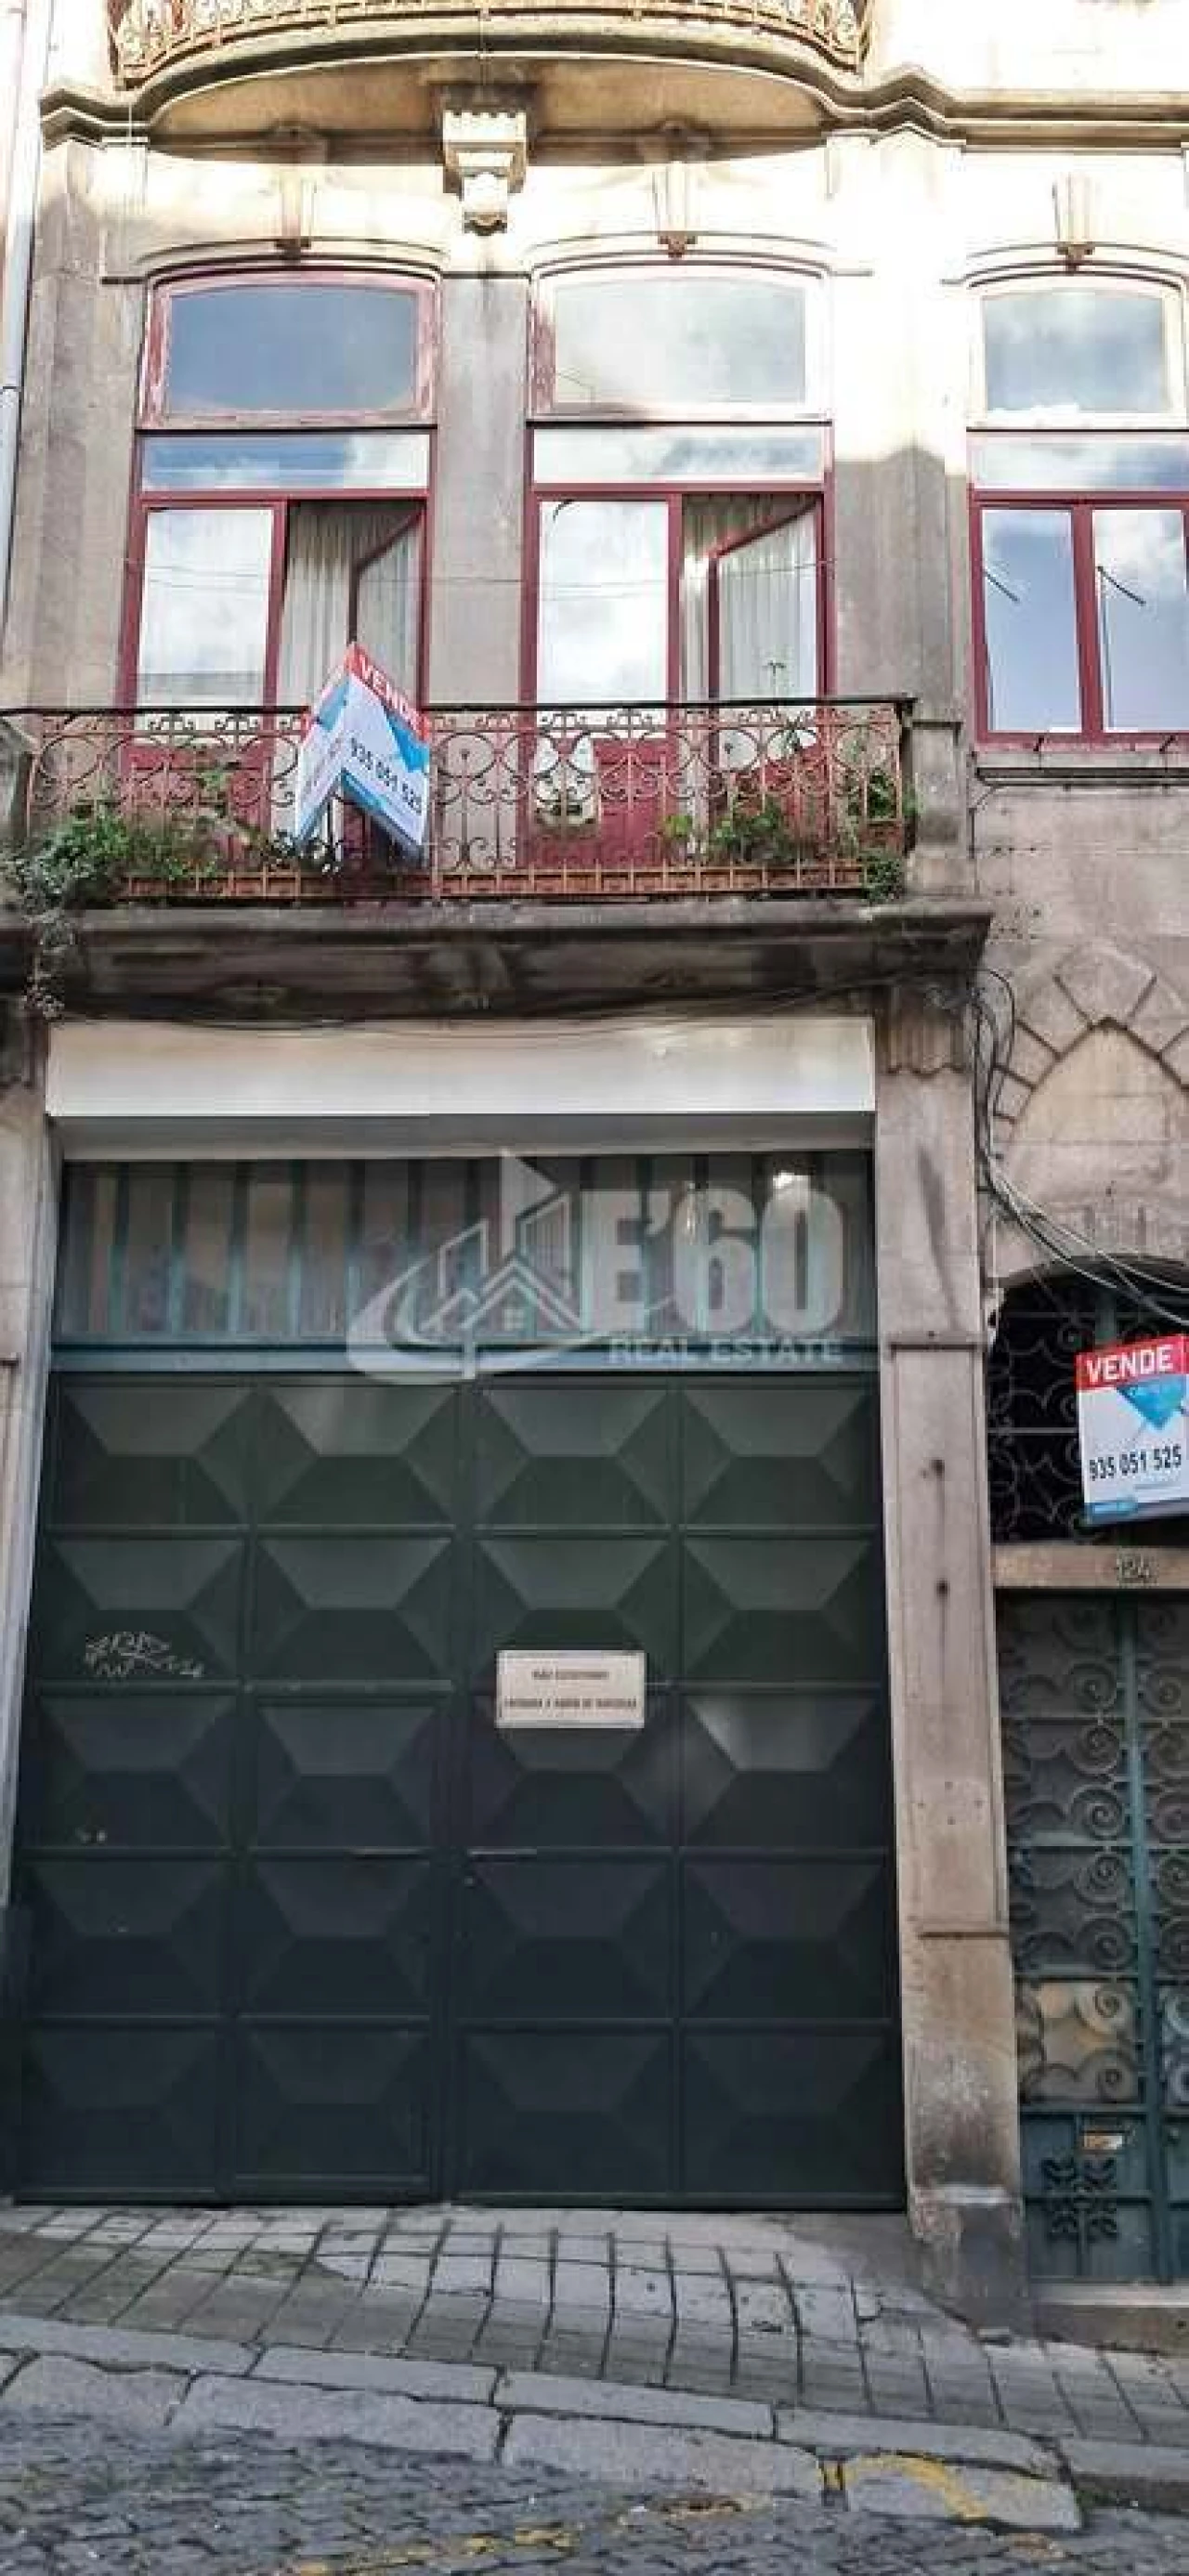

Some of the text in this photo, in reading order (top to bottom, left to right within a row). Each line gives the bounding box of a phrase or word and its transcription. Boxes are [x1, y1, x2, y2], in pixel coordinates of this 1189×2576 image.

[360, 655, 423, 731] VENDE
[349, 737, 373, 771] 935
[376, 760, 399, 792] 051
[1086, 1345, 1173, 1383] VENDE
[1089, 1443, 1182, 1481] 935 051 525
